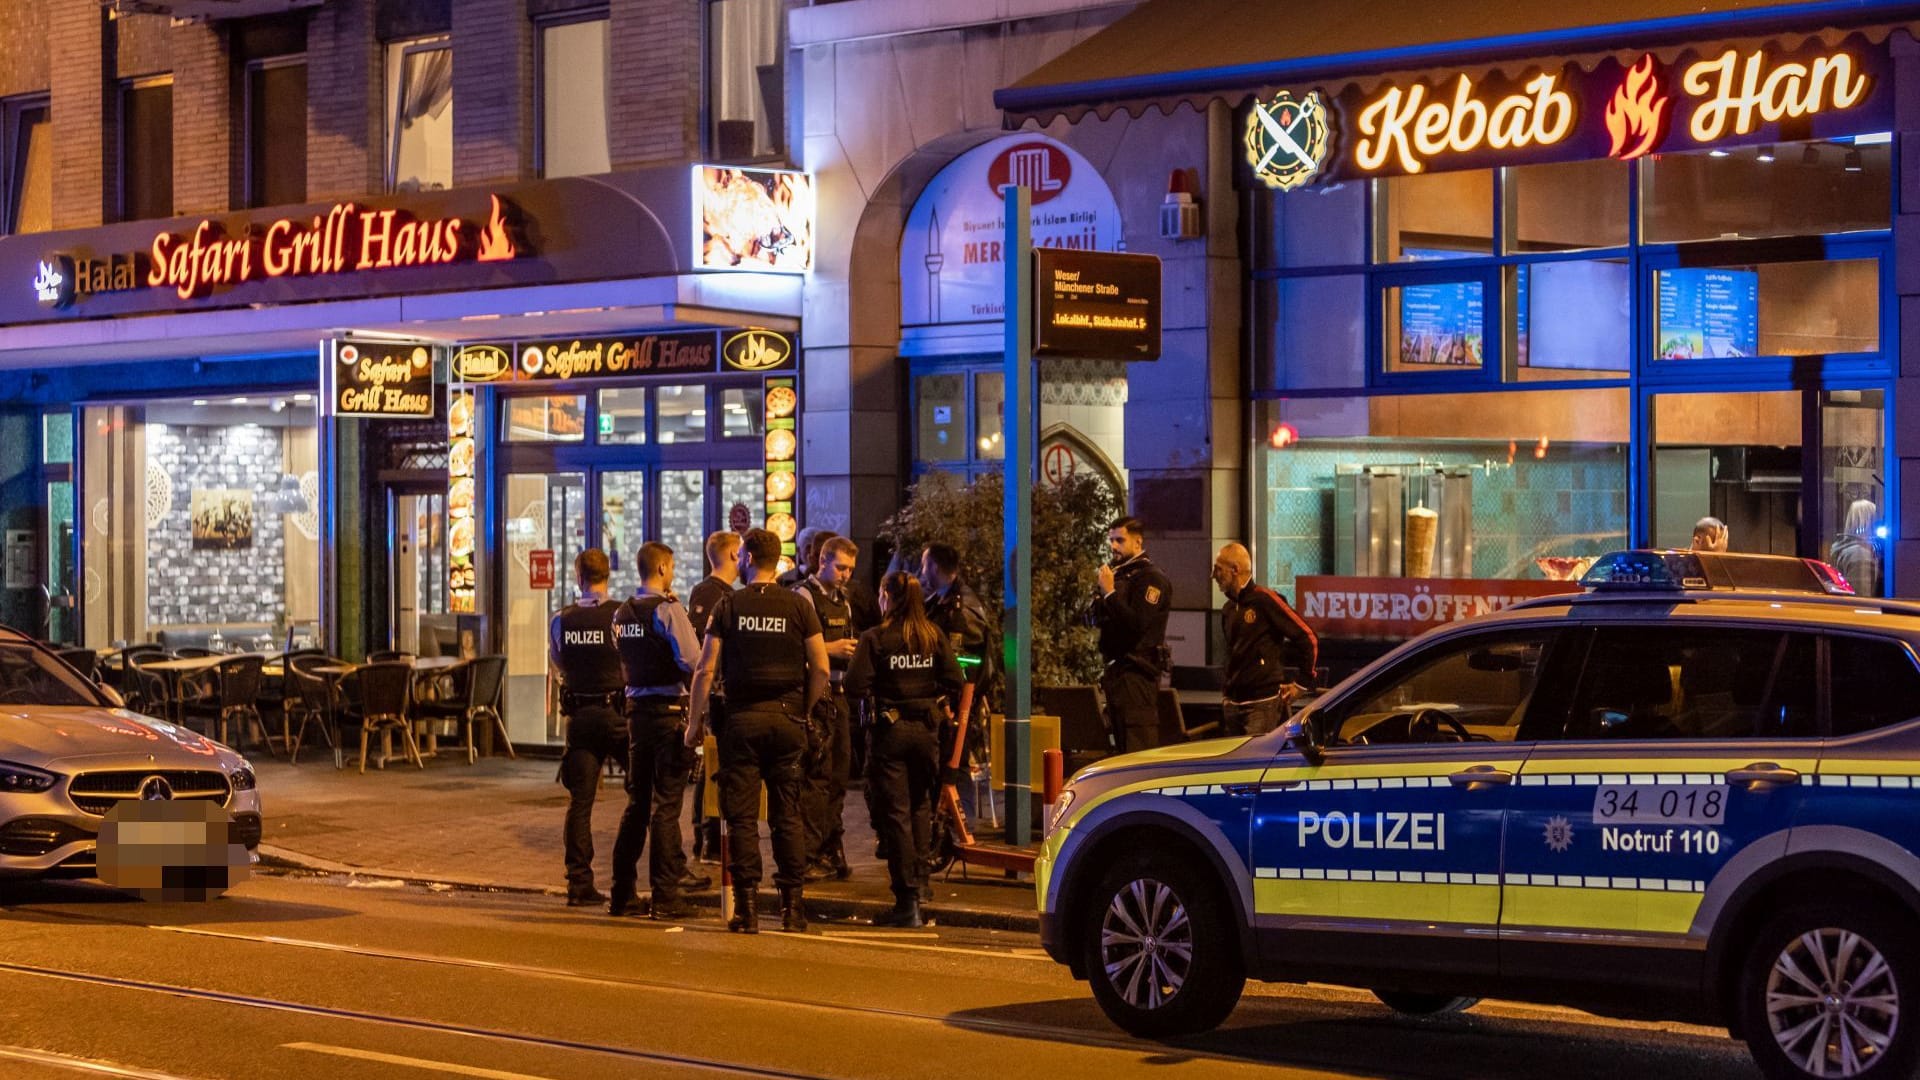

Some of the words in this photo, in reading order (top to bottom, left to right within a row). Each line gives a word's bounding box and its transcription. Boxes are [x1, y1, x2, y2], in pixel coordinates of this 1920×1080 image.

[1356, 73, 1572, 173] Kebab
[1683, 50, 1865, 142] Han
[148, 219, 251, 299] Safari
[262, 202, 354, 277] Grill
[356, 209, 461, 271] Haus
[74, 251, 135, 292] Halal
[1055, 269, 1080, 281] Weser/
[1054, 281, 1094, 294] Münchener
[1095, 283, 1119, 296] Straße
[359, 355, 412, 385] Safari
[462, 350, 499, 375] Halal
[544, 340, 602, 379] Safari
[606, 336, 657, 371] Grill
[657, 339, 712, 368] Haus
[341, 385, 384, 411] Grill
[383, 389, 429, 412] Haus
[565, 630, 604, 645] POLIZEI
[616, 623, 644, 638] POLIZEI
[739, 616, 786, 633] POLIZEI
[1600, 789, 1639, 818] 34
[1660, 789, 1722, 819] 018
[1298, 810, 1445, 850] POLIZEI
[1602, 827, 1674, 853] Notruf
[1680, 829, 1720, 854] 110
